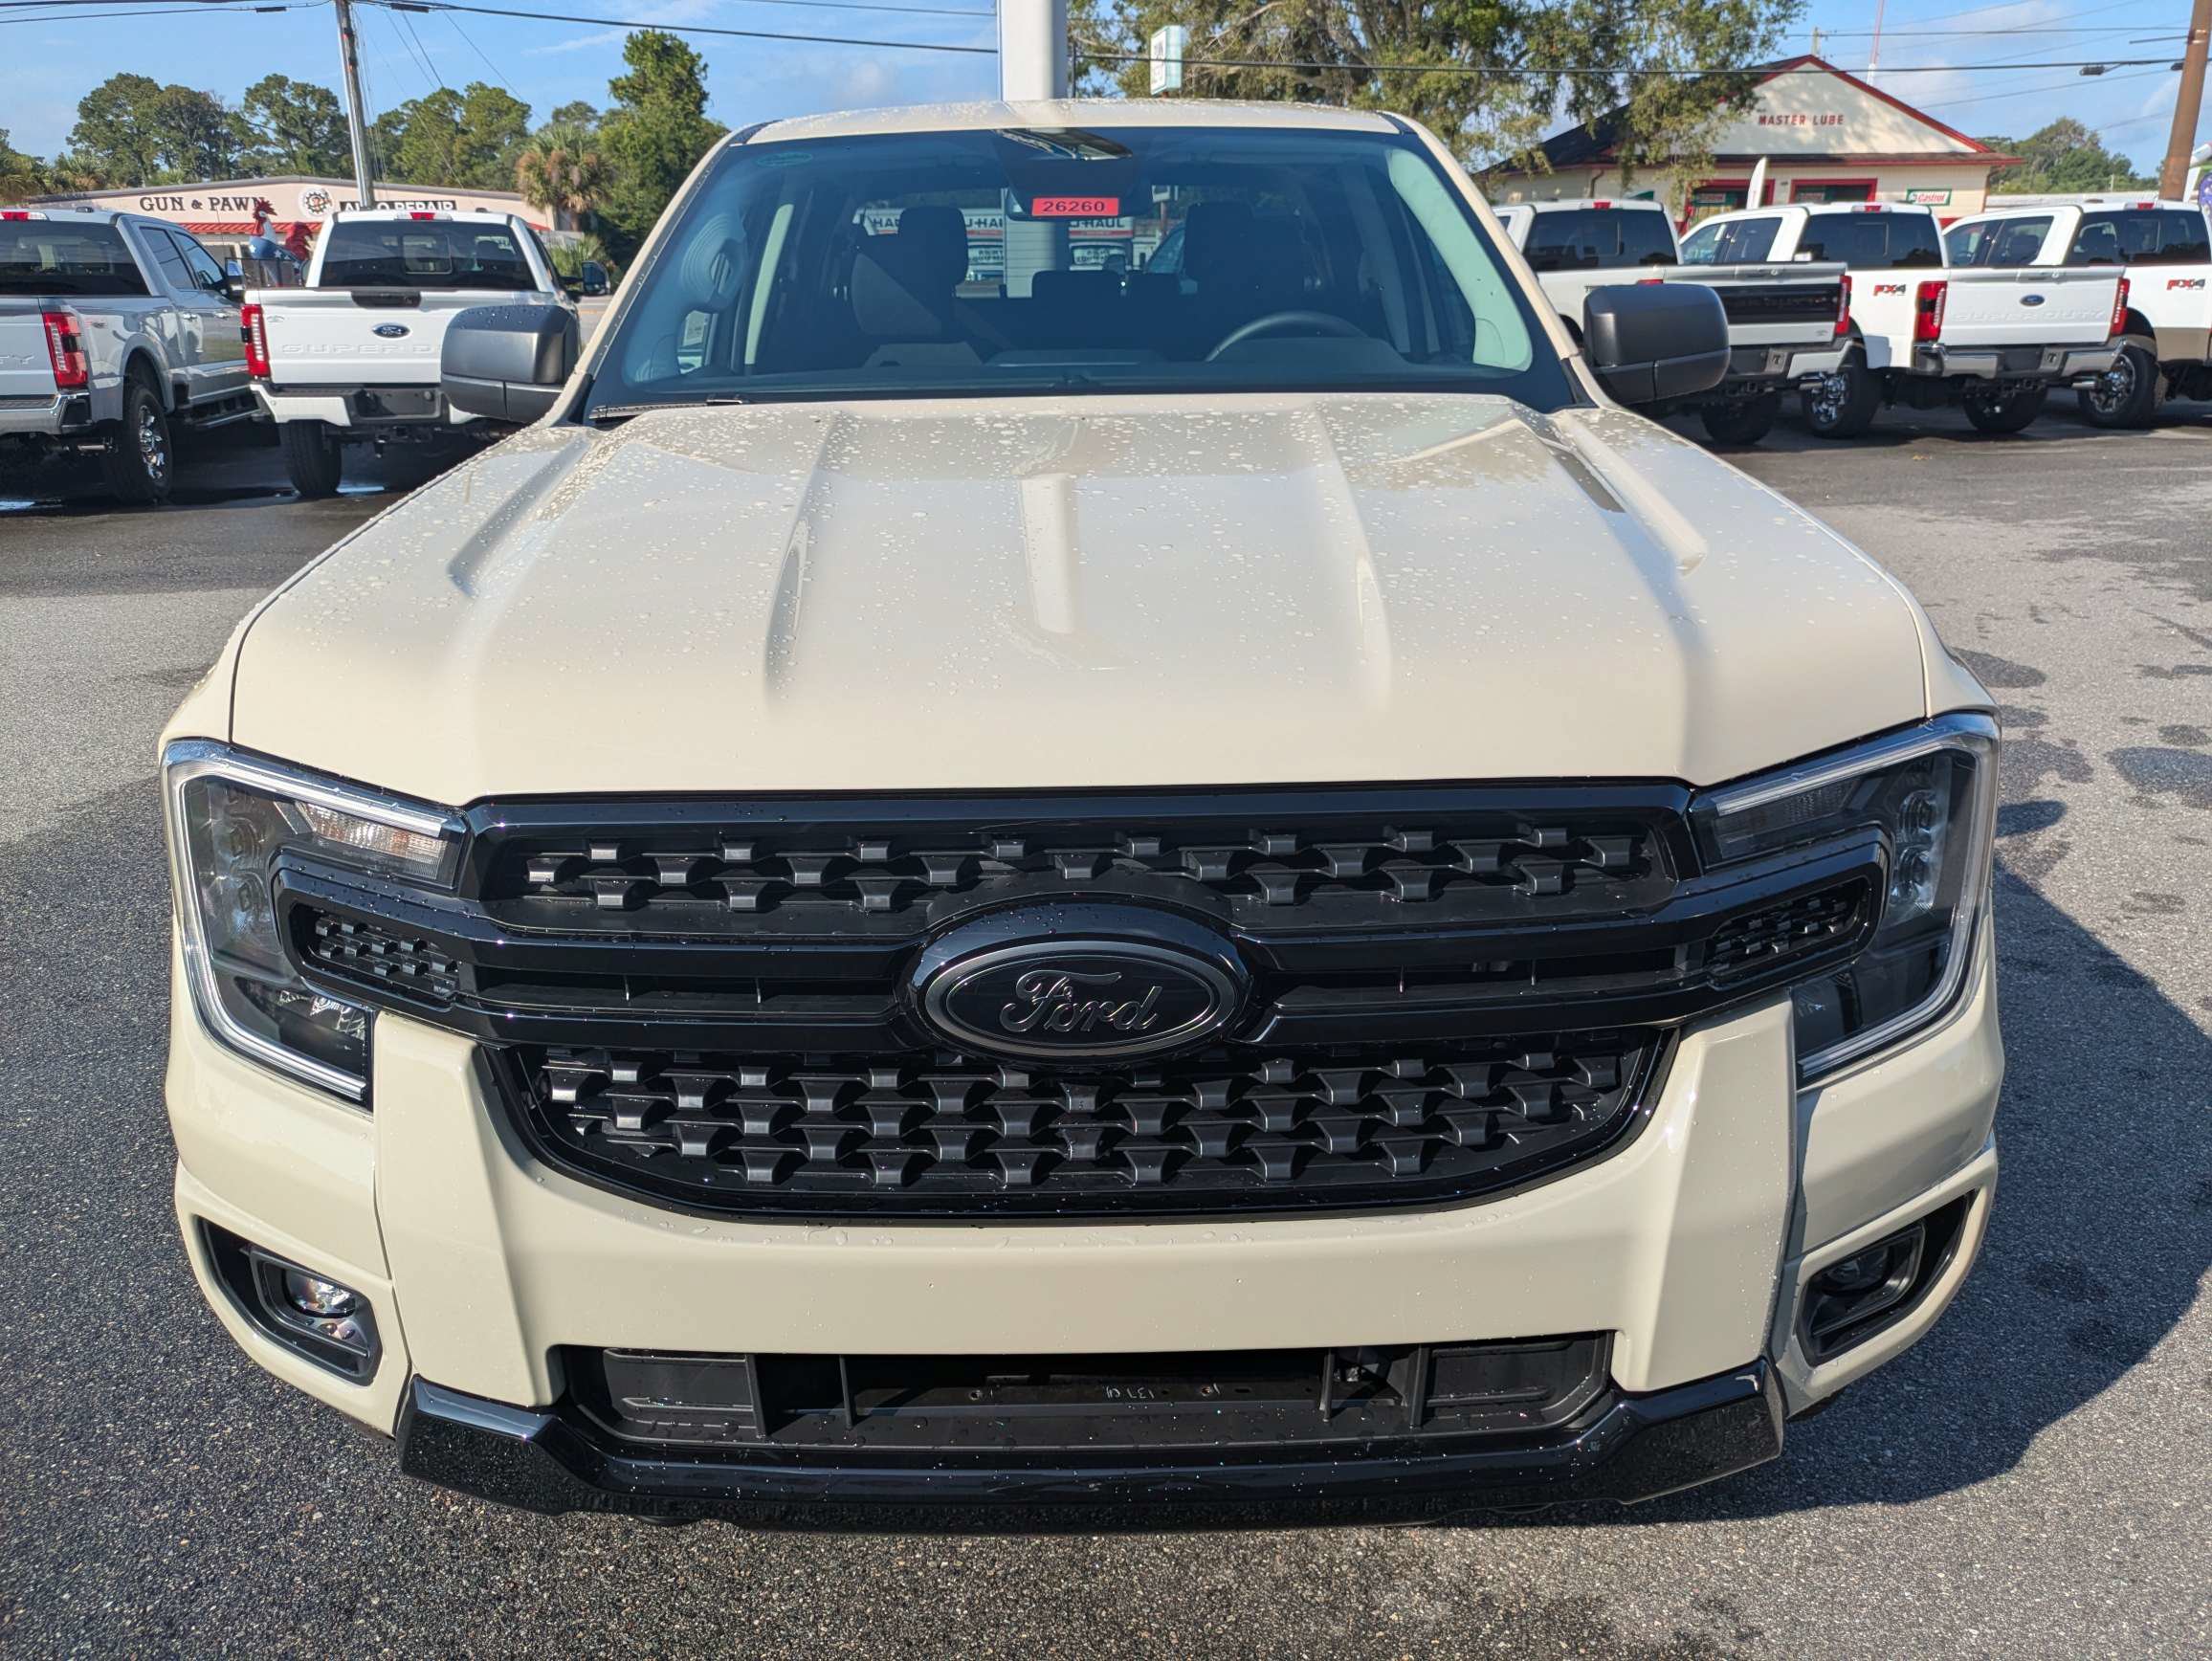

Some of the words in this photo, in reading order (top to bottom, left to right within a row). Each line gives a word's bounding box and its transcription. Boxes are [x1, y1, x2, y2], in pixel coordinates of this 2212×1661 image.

[1759, 114, 1806, 125] MASTER
[1812, 114, 1845, 125] LUBE
[139, 196, 185, 211] GUN
[190, 199, 203, 210] &
[1042, 200, 1105, 212] 26260
[1872, 283, 1907, 296] FX4
[2166, 278, 2206, 291] FX4
[1000, 969, 1162, 1032] Ford
